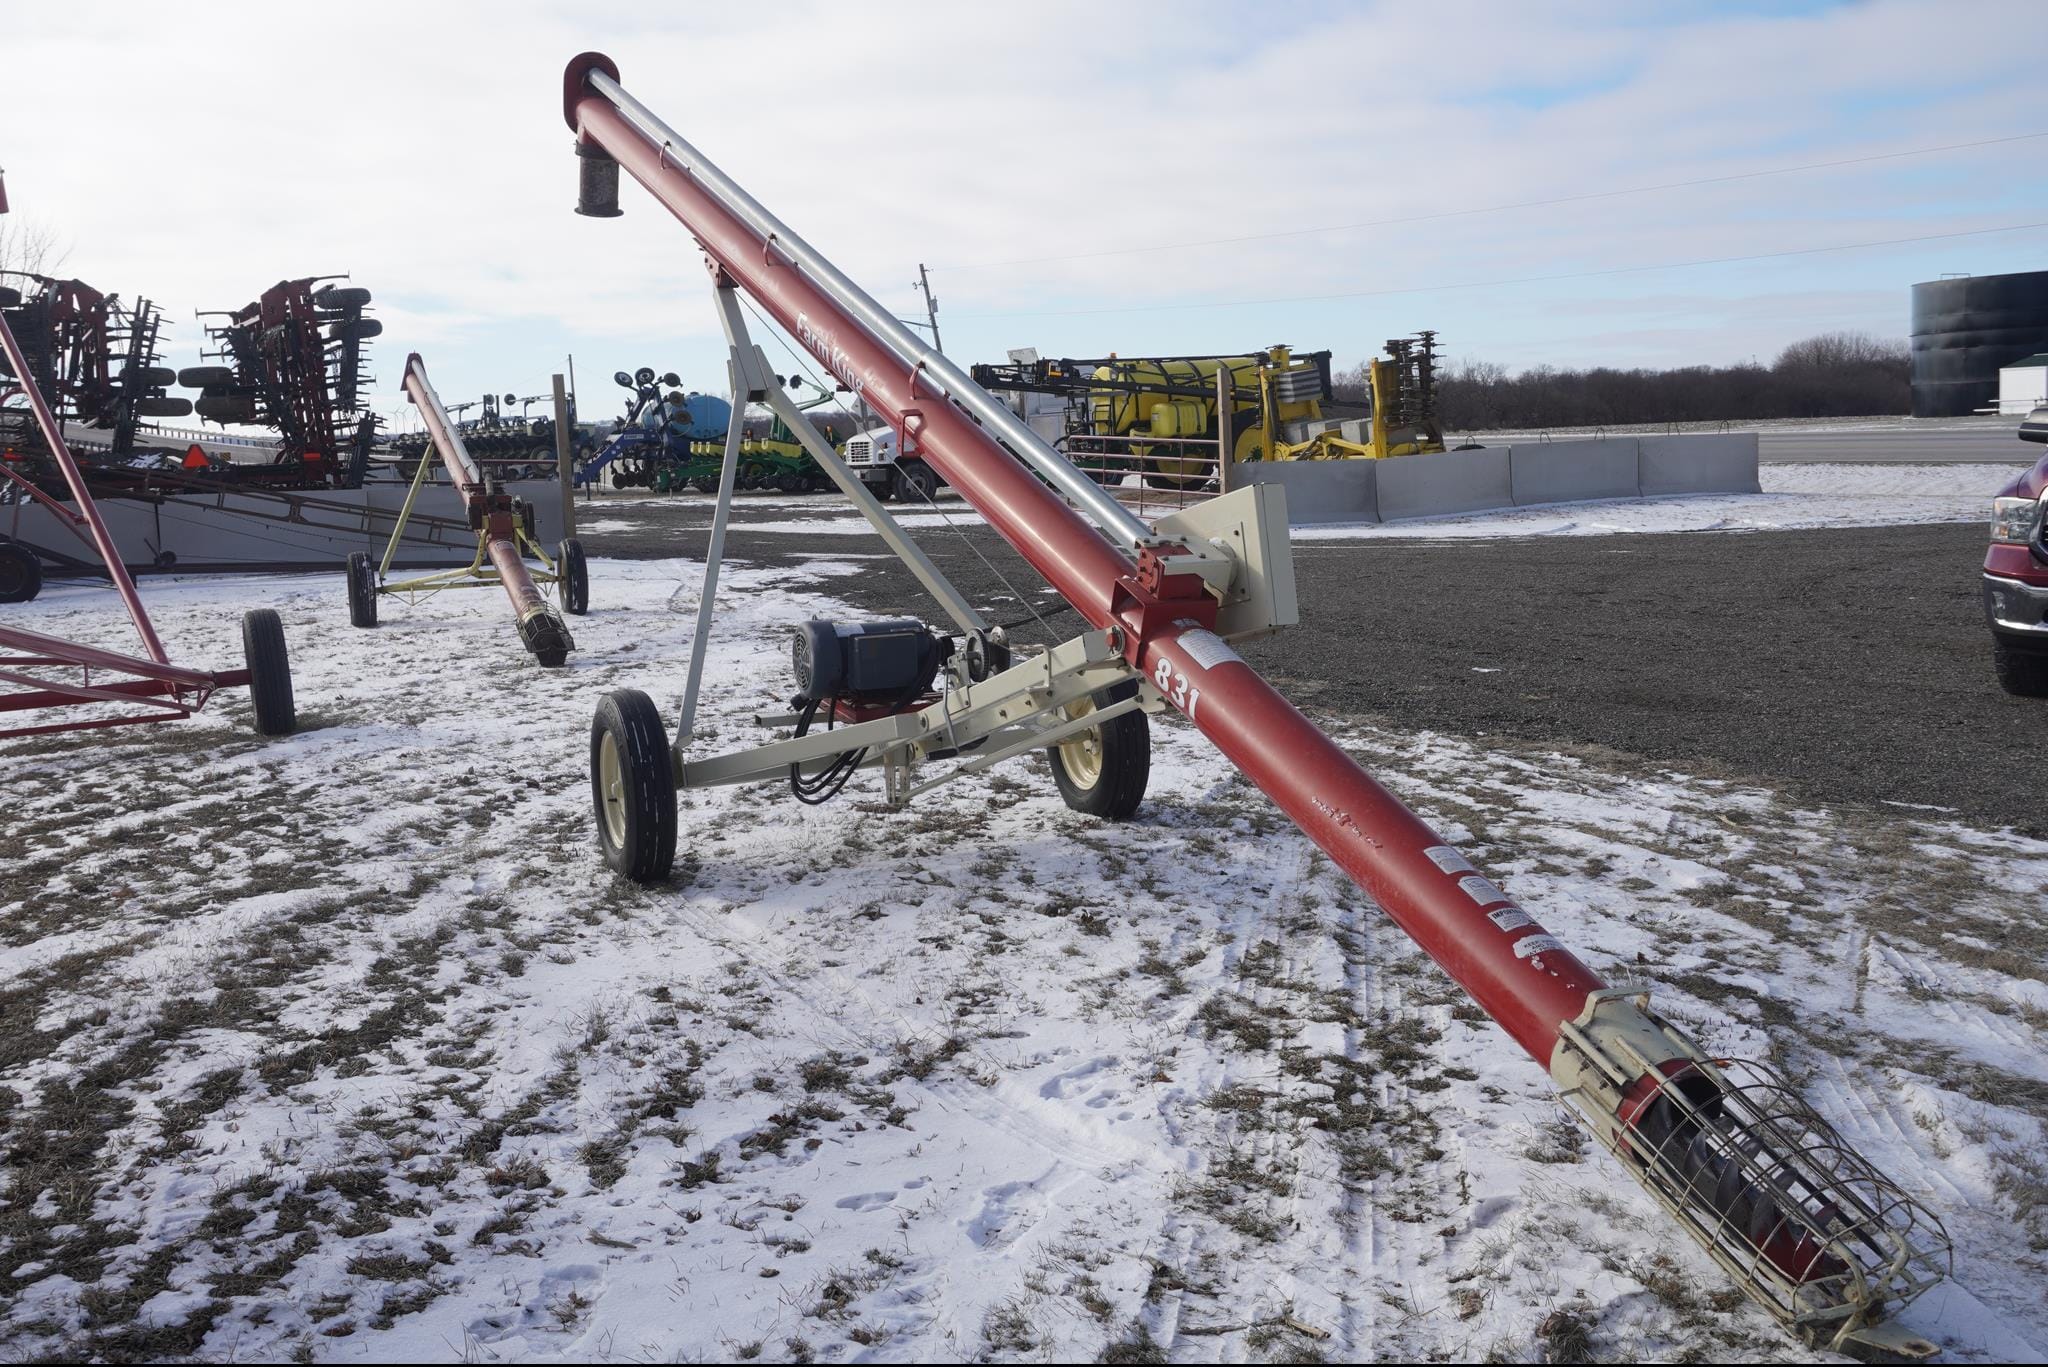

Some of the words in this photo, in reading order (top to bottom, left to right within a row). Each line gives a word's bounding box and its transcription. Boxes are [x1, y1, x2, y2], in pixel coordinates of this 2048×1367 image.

[796, 311, 830, 364] Farm
[831, 346, 864, 395] King
[1154, 657, 1200, 720] 831
[1491, 908, 1526, 919] IMPORT
